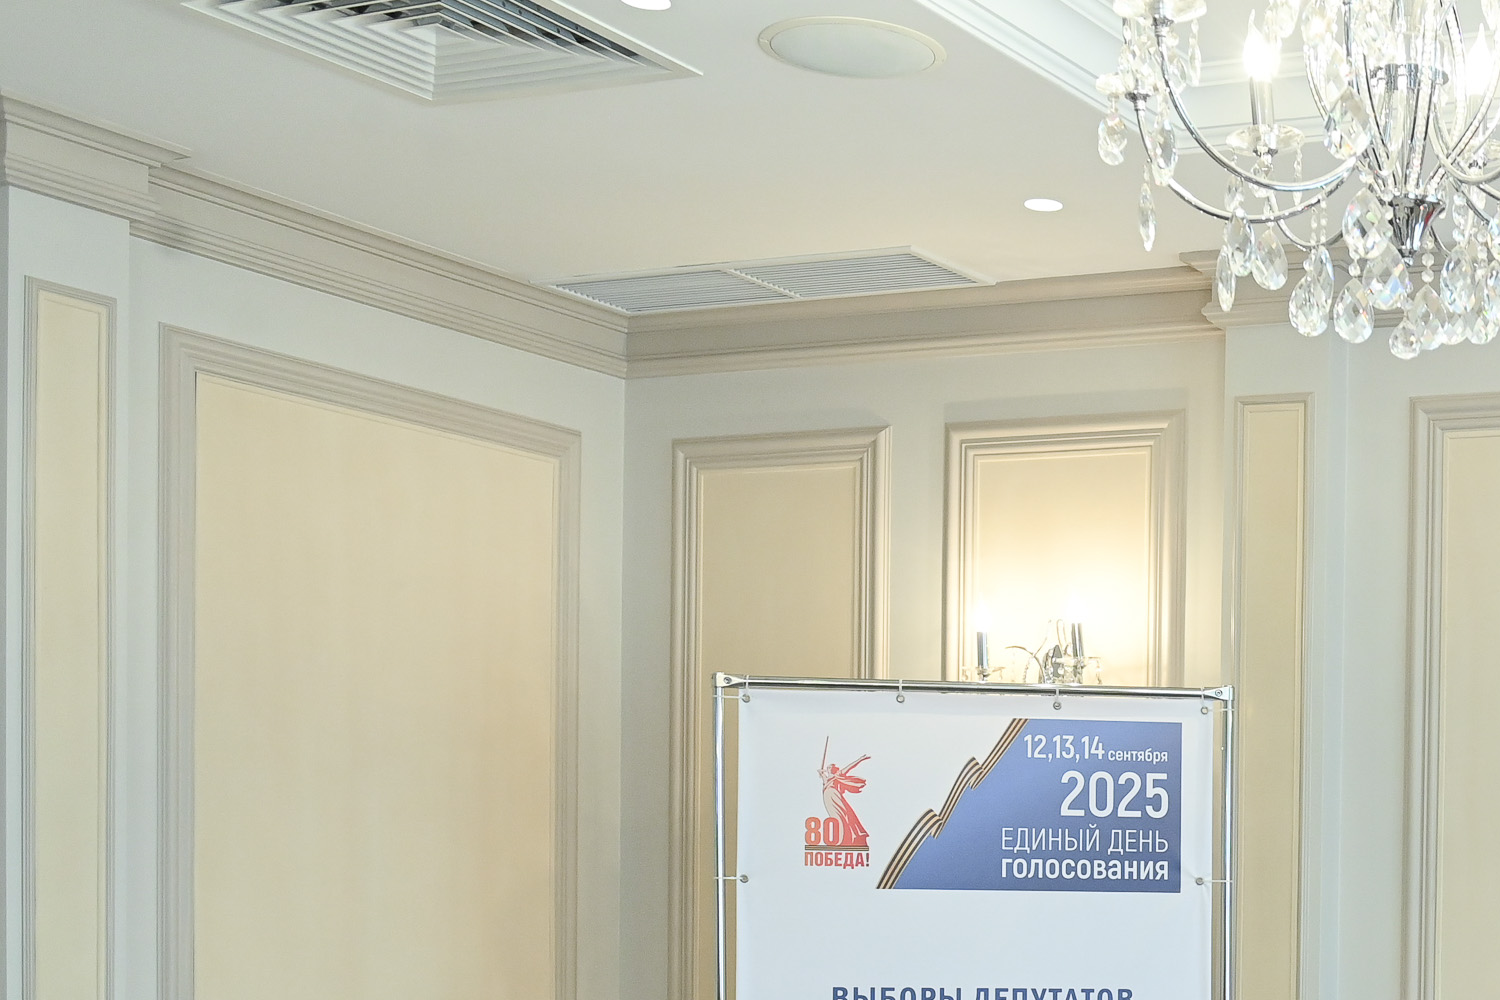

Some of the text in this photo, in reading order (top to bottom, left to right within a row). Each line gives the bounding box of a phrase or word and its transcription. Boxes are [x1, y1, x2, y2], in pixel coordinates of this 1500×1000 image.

[1024, 734, 1168, 765] 12,13,14 сентября
[1060, 770, 1169, 819] 2025
[804, 816, 840, 846] 80
[1001, 823, 1169, 855] ЕДИНЫЙ ДЕНЬ
[804, 851, 870, 869] ПОБЕДА!
[1001, 858, 1169, 881] голосования
